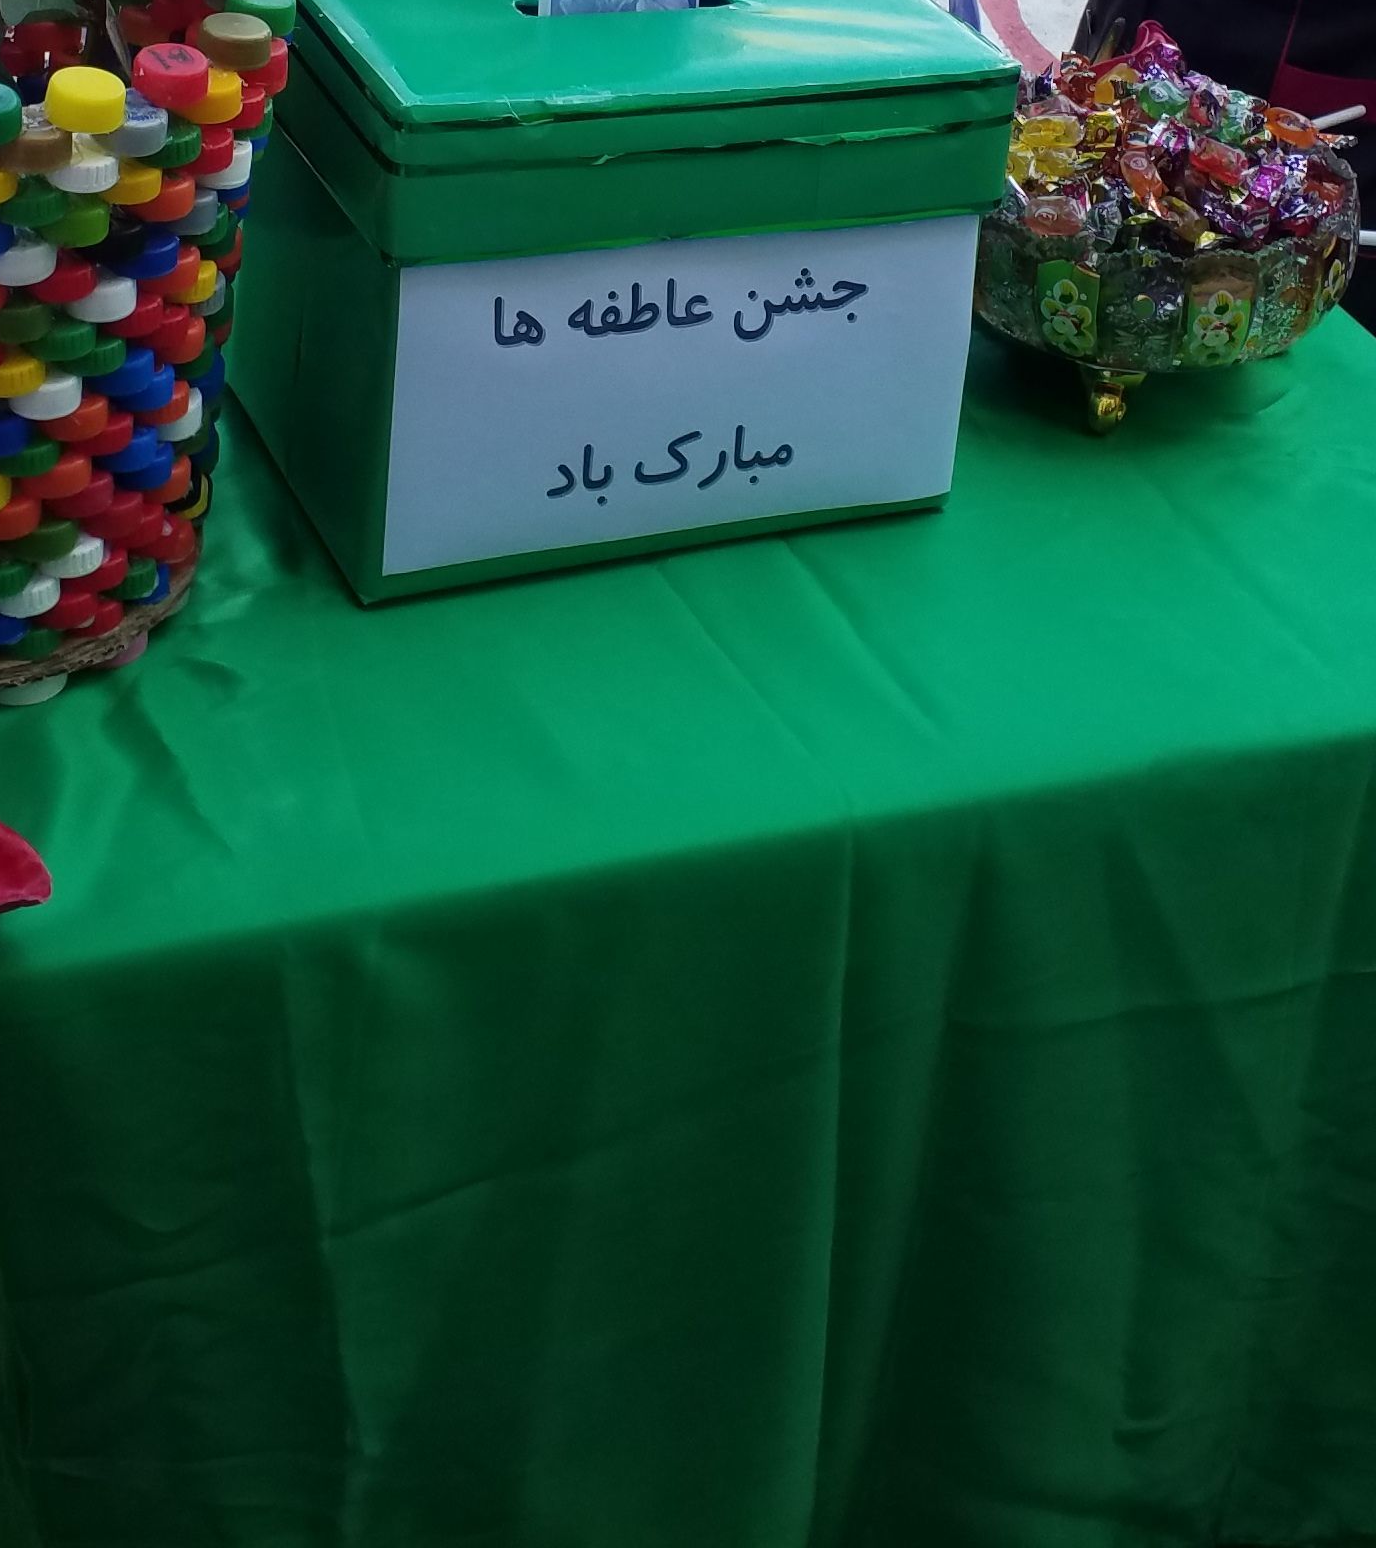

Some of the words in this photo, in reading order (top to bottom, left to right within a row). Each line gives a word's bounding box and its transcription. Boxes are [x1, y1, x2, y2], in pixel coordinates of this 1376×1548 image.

[492, 296, 546, 347] ها
[567, 277, 714, 338] عاطفه
[732, 268, 869, 341] جشن
[546, 443, 614, 506] باد
[633, 424, 795, 491] مبارک
